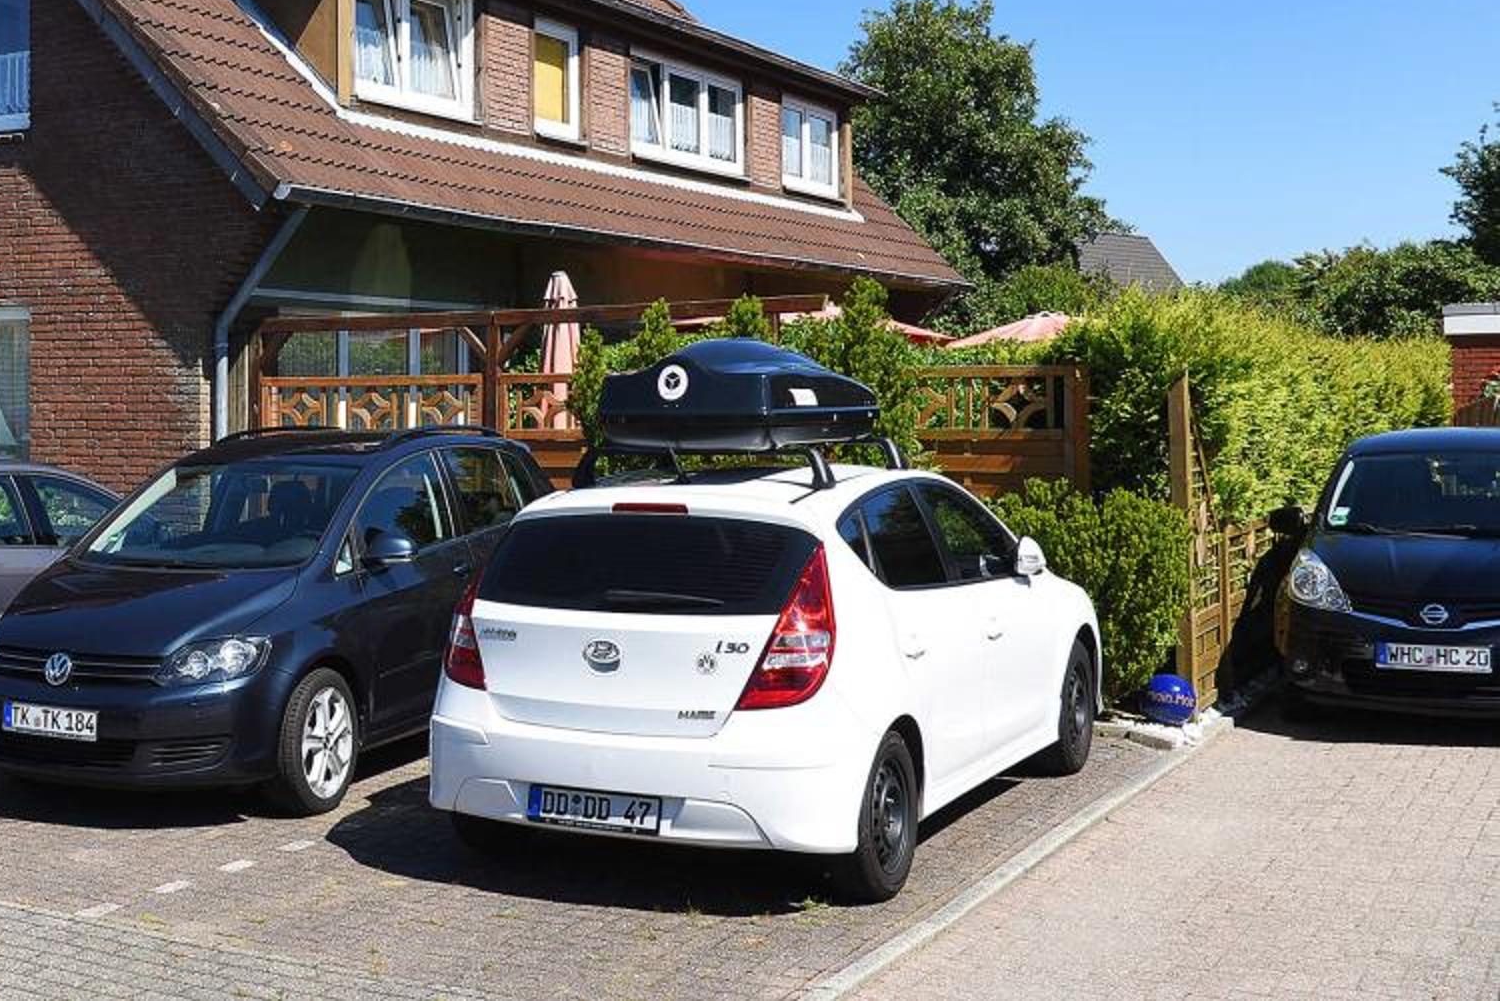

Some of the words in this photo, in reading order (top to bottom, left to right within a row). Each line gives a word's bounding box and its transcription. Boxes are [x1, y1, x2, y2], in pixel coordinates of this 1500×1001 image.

[1388, 646, 1424, 665] WHC
[1435, 647, 1460, 666] HC
[1465, 649, 1489, 667] 20
[13, 705, 29, 725] TK
[42, 708, 61, 730] TK
[64, 711, 95, 734] 184
[541, 790, 569, 816] DD
[582, 795, 611, 821] DD
[623, 799, 653, 826] 47
